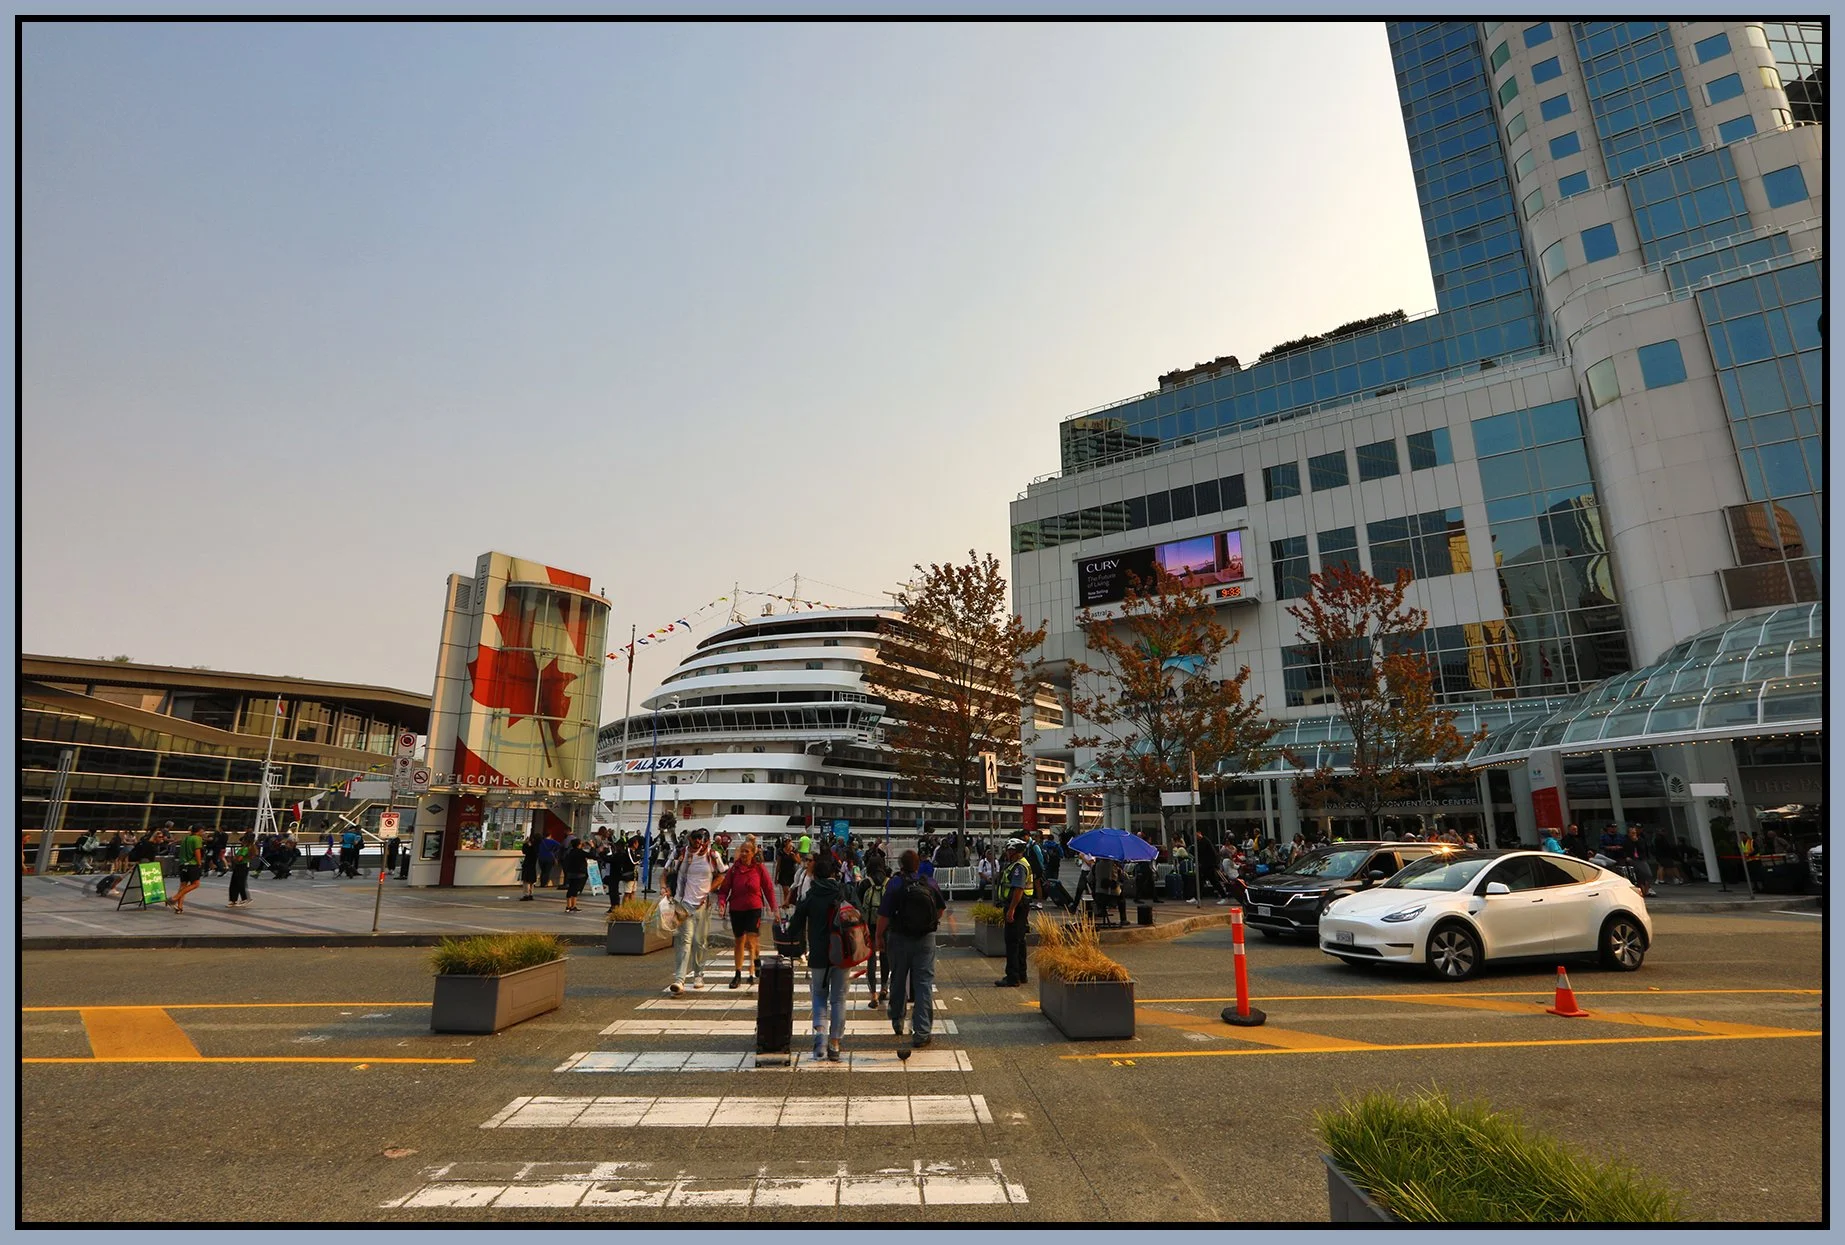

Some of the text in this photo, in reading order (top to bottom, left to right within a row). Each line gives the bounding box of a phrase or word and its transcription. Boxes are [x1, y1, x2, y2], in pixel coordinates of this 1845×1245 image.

[1086, 559, 1120, 573] CURV
[633, 758, 684, 770] ALASKA
[436, 773, 509, 785] WELCOME
[518, 777, 569, 788] CENTRE
[1442, 798, 1476, 807] CENTRE
